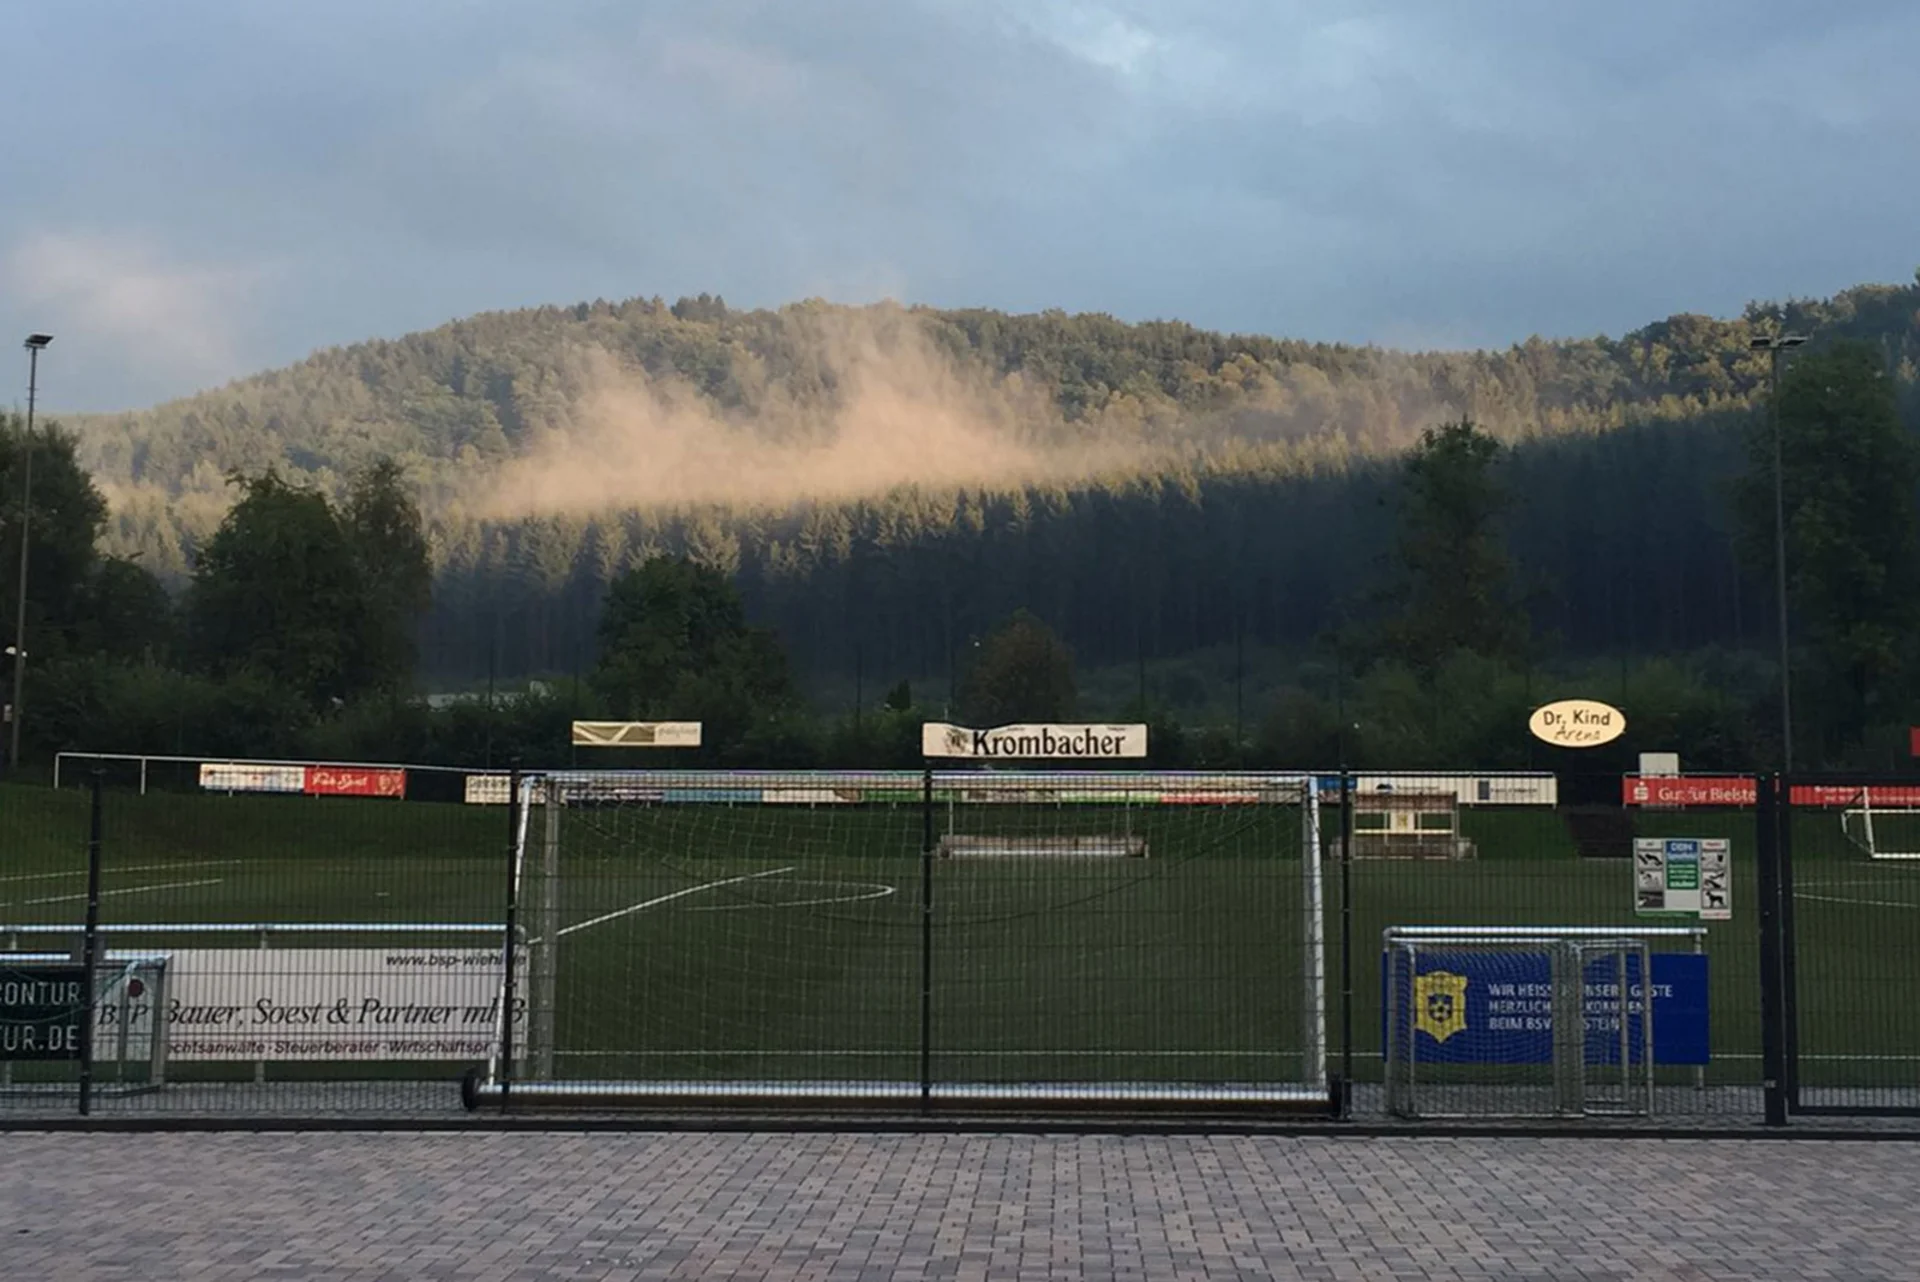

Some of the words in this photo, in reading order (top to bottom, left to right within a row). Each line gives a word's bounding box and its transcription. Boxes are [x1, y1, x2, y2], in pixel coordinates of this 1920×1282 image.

[1543, 710, 1567, 726] Dr.
[1572, 709, 1612, 726] Kind
[1554, 724, 1601, 742] Arena
[972, 728, 1127, 756] Krombacher
[1710, 786, 1758, 802] Bielste
[386, 954, 527, 969] www.bsp-wiehle
[1488, 984, 1516, 997] WIR
[1630, 984, 1674, 997] GSTE
[168, 998, 244, 1028] Bauer,
[252, 998, 323, 1025] Soest
[326, 997, 350, 1025] &
[358, 997, 457, 1025] Partner
[1526, 1017, 1551, 1030] BSV
[0, 1025, 80, 1052] UR.DE
[168, 1041, 266, 1055] chtsanwälte
[274, 1041, 380, 1055] Steuerberater
